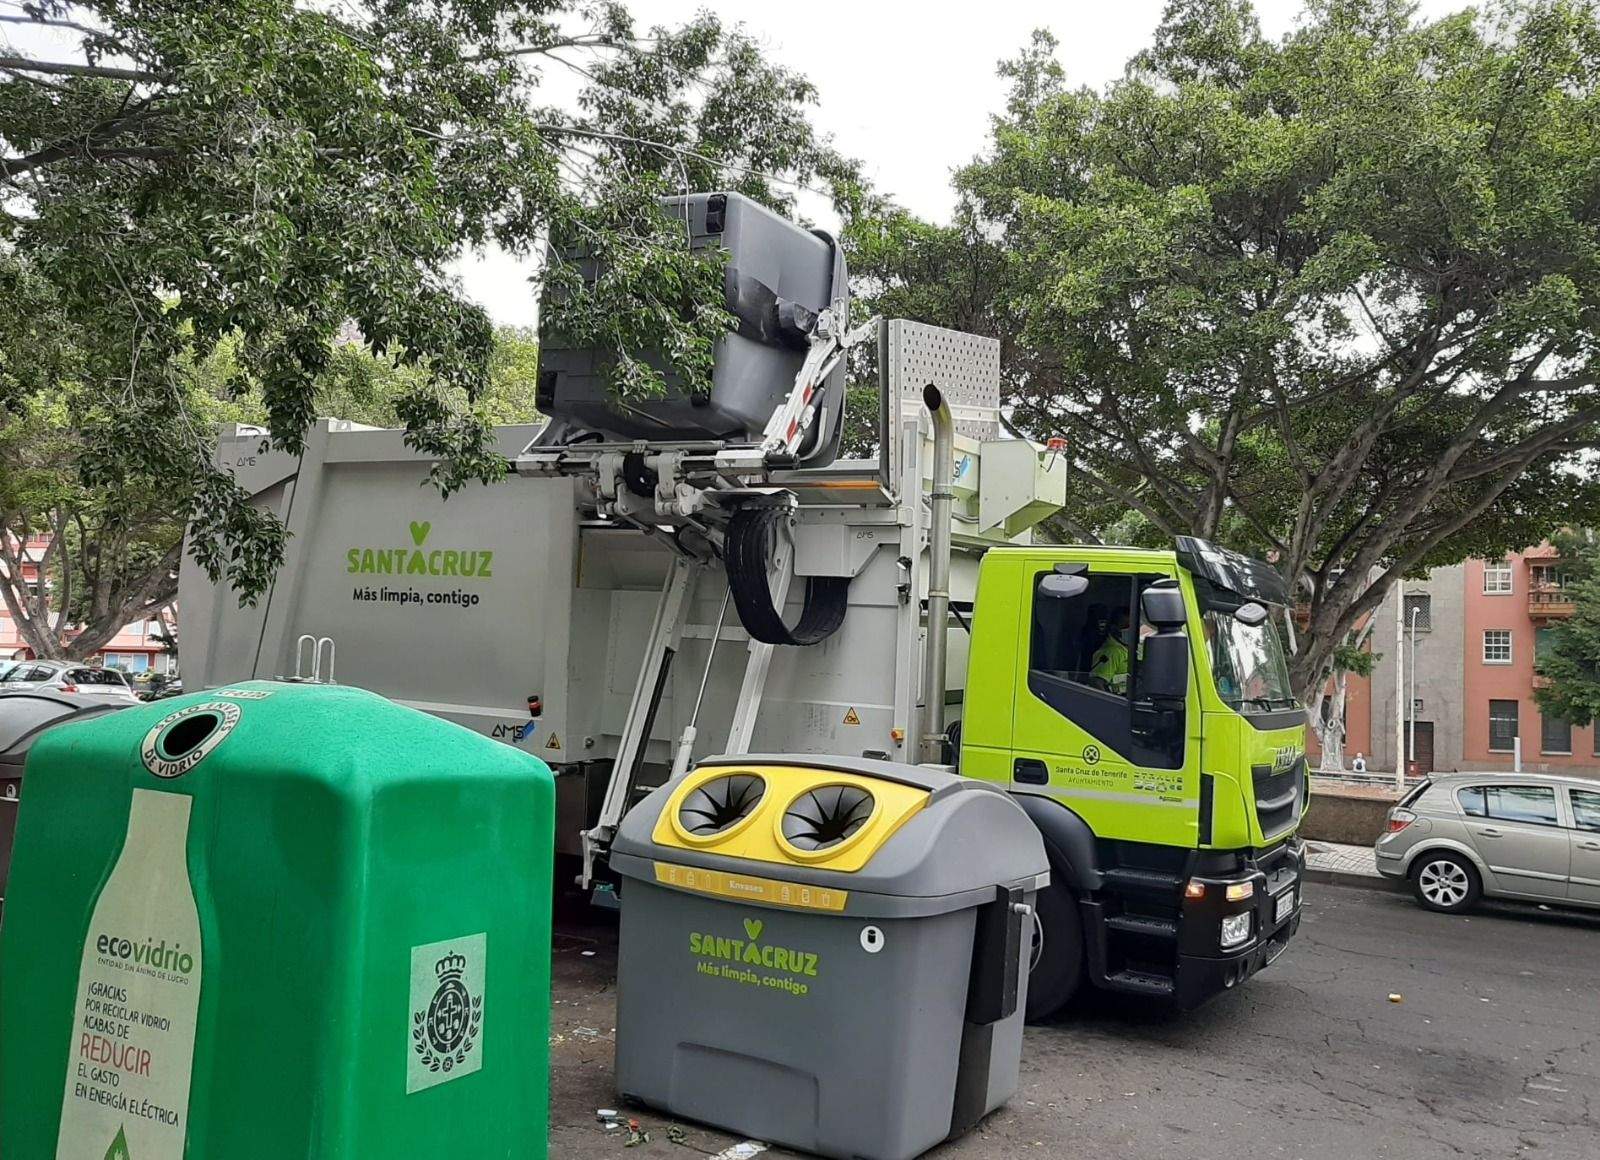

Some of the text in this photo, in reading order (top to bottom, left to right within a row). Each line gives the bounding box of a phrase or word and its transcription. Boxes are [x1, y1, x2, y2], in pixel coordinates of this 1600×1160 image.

[353, 587, 480, 608] Más limpia, contigo
[155, 702, 239, 732] SOLO ENVASES
[144, 748, 204, 776] DE VIDRIO
[1056, 766, 1074, 776] Santa
[1075, 768, 1091, 776] Cruz
[1101, 770, 1128, 779] Tenerife
[1068, 777, 1114, 787] AYUNTAMIENTO
[729, 880, 763, 894] Envases
[96, 934, 193, 974] ecovidrio
[97, 957, 123, 970] ENTIDAD
[125, 964, 134, 973] SIN
[157, 971, 166, 980] DE
[168, 974, 189, 985] LUCRO
[697, 962, 808, 995] Más limpia, contigo
[86, 998, 101, 1013] POR
[102, 1002, 139, 1021] RECICLAR
[83, 1015, 130, 1039] ACABAS DE
[80, 1033, 151, 1077] REDUCIR
[77, 1063, 119, 1087] EL GASTO
[75, 1082, 179, 1126] EN ENERGÍA ELÉCTRICA
